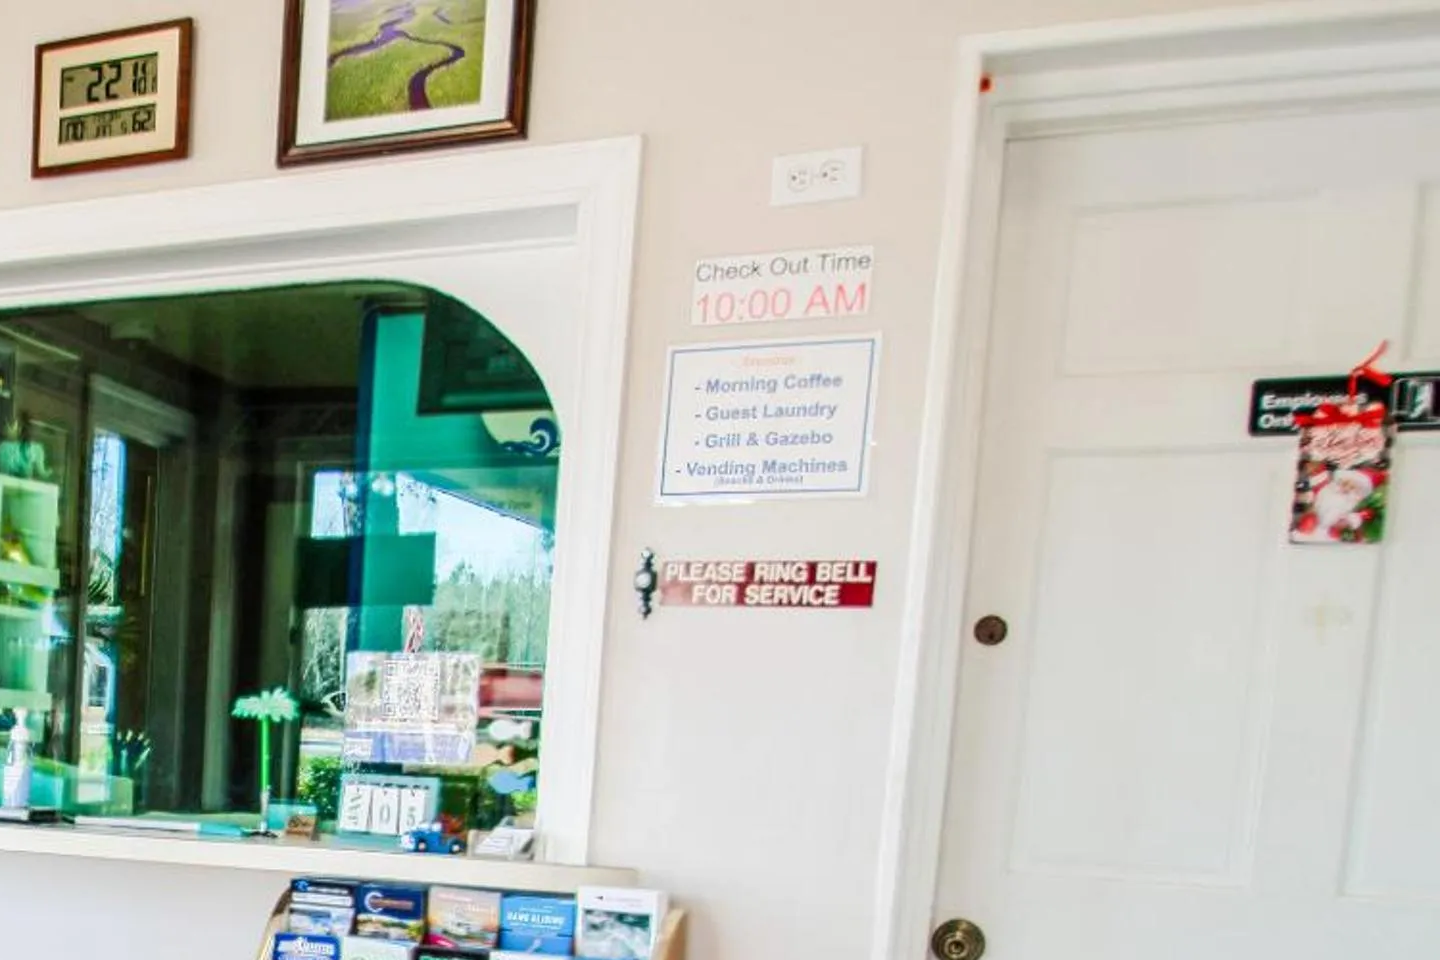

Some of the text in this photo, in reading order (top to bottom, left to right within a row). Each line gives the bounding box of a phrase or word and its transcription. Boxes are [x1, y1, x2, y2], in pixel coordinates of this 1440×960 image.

[696, 253, 871, 282] Check Out Time
[697, 282, 866, 323] 10:00 AM
[705, 375, 778, 394] Morning
[784, 373, 843, 390] Coffee
[706, 405, 758, 421] Guest
[763, 402, 838, 420] Laundry
[705, 433, 741, 449] Grill
[745, 433, 759, 447] &
[765, 430, 833, 447] Gazebo
[686, 460, 755, 477] Vending
[762, 458, 848, 474] Machines
[665, 562, 872, 583] PLEASE RING BELL
[691, 585, 840, 605] FOR SERVICE
